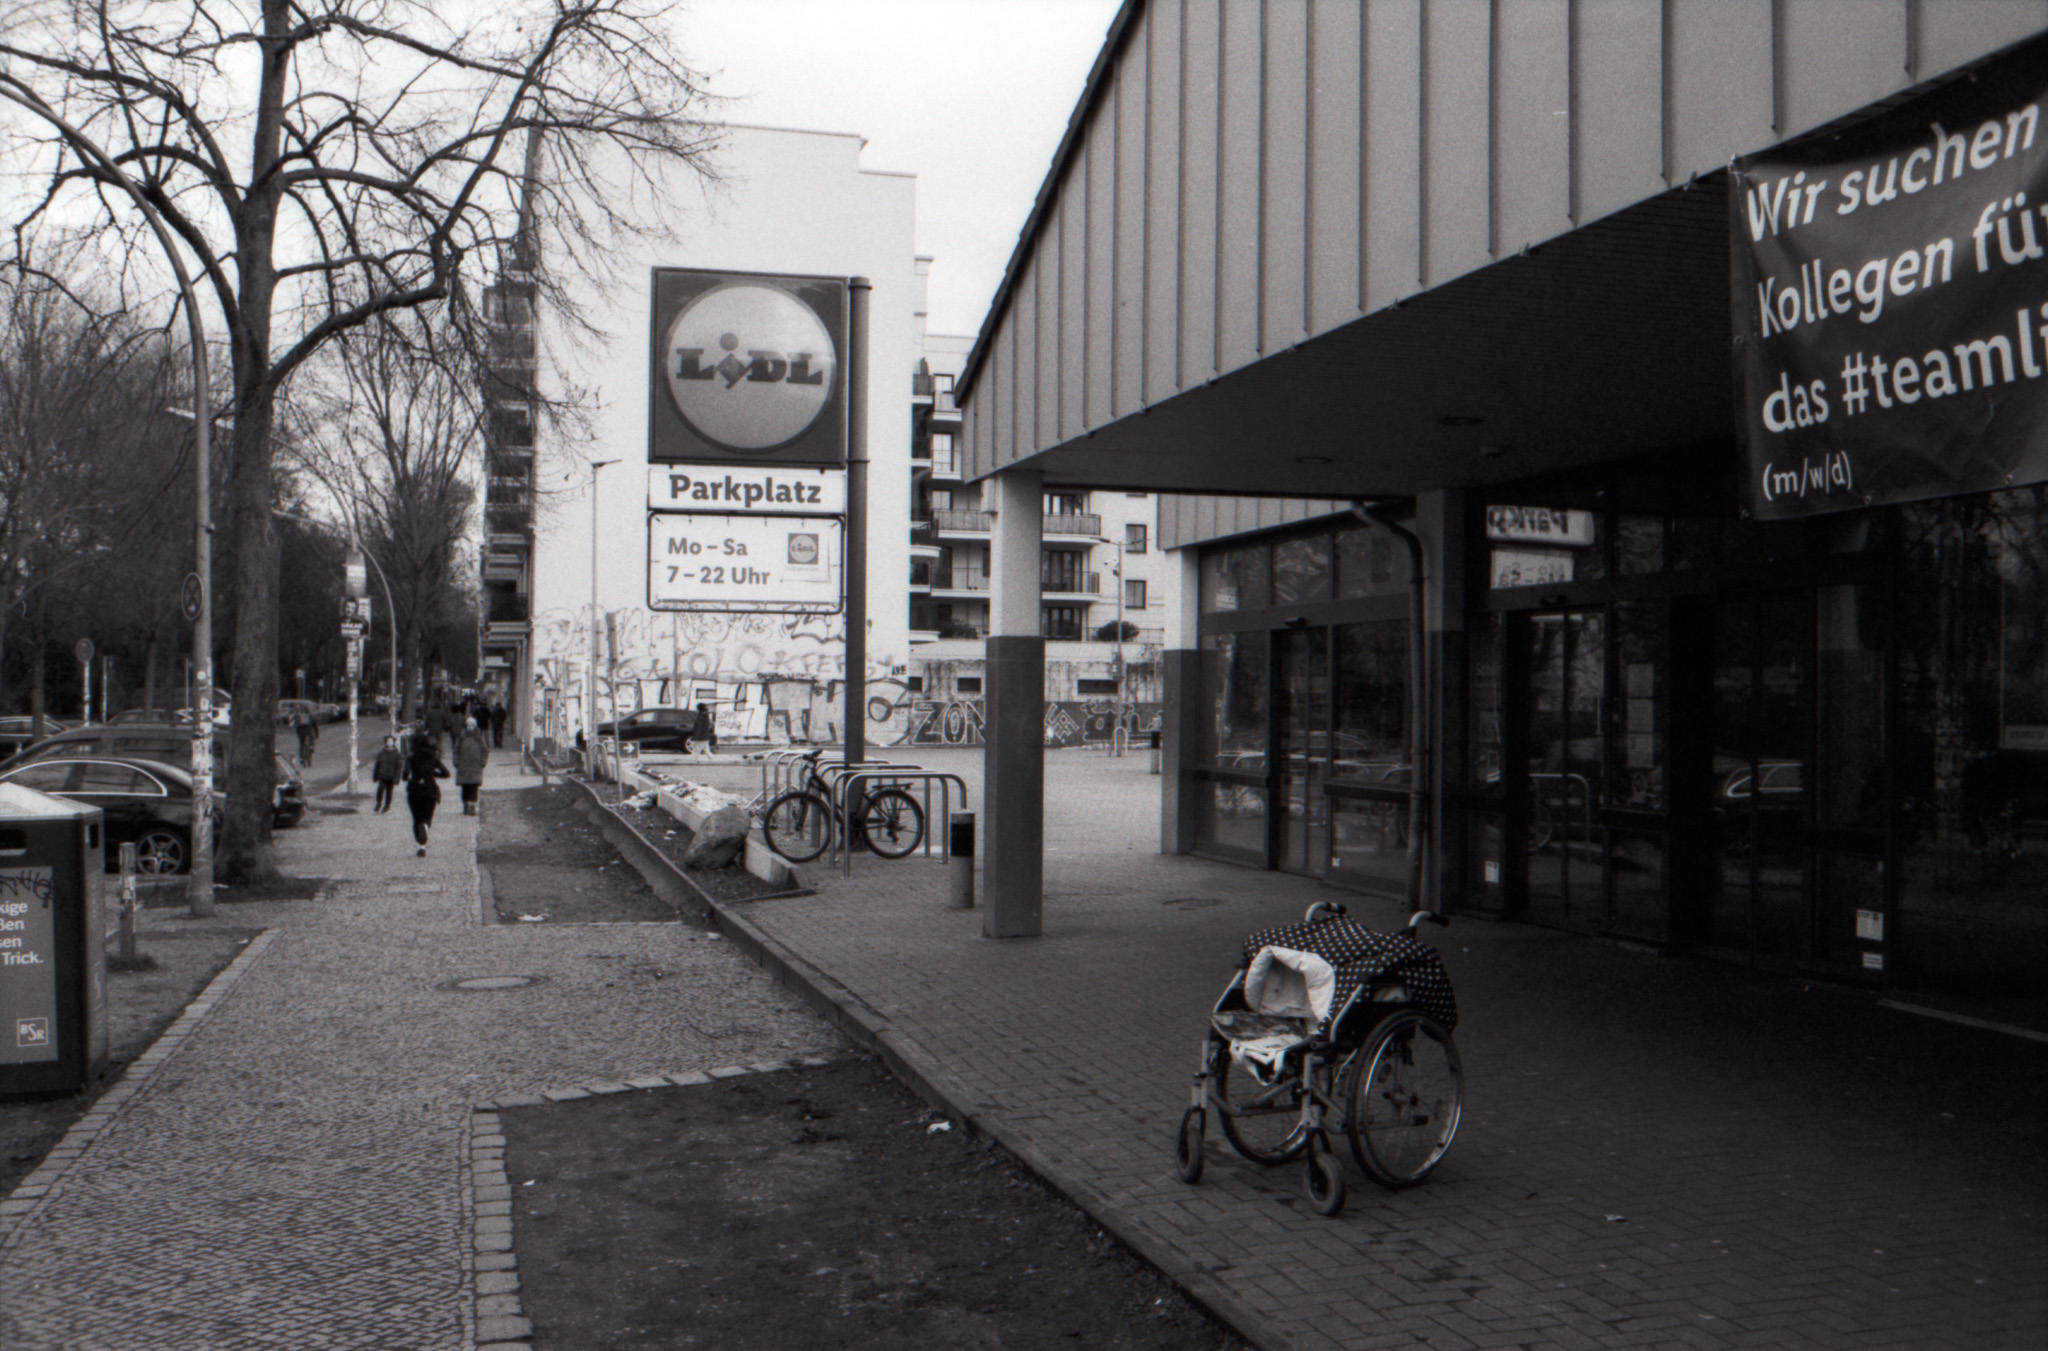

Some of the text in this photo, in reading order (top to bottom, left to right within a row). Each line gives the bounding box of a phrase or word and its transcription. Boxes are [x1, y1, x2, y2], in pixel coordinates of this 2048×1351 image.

[1747, 104, 2040, 242] Wir suchen
[1757, 191, 2048, 339] Kollegen fü
[1762, 371, 1830, 433] das
[669, 474, 822, 508] Parkplatz
[1762, 450, 1852, 500] (m/w/d)
[667, 537, 702, 555] Mo
[723, 538, 748, 556] Sa
[667, 566, 679, 583] 7
[700, 566, 725, 584] 22
[731, 567, 770, 585] Uhr
[1, 950, 44, 965] Trick.
[20, 1023, 45, 1041] BSR
